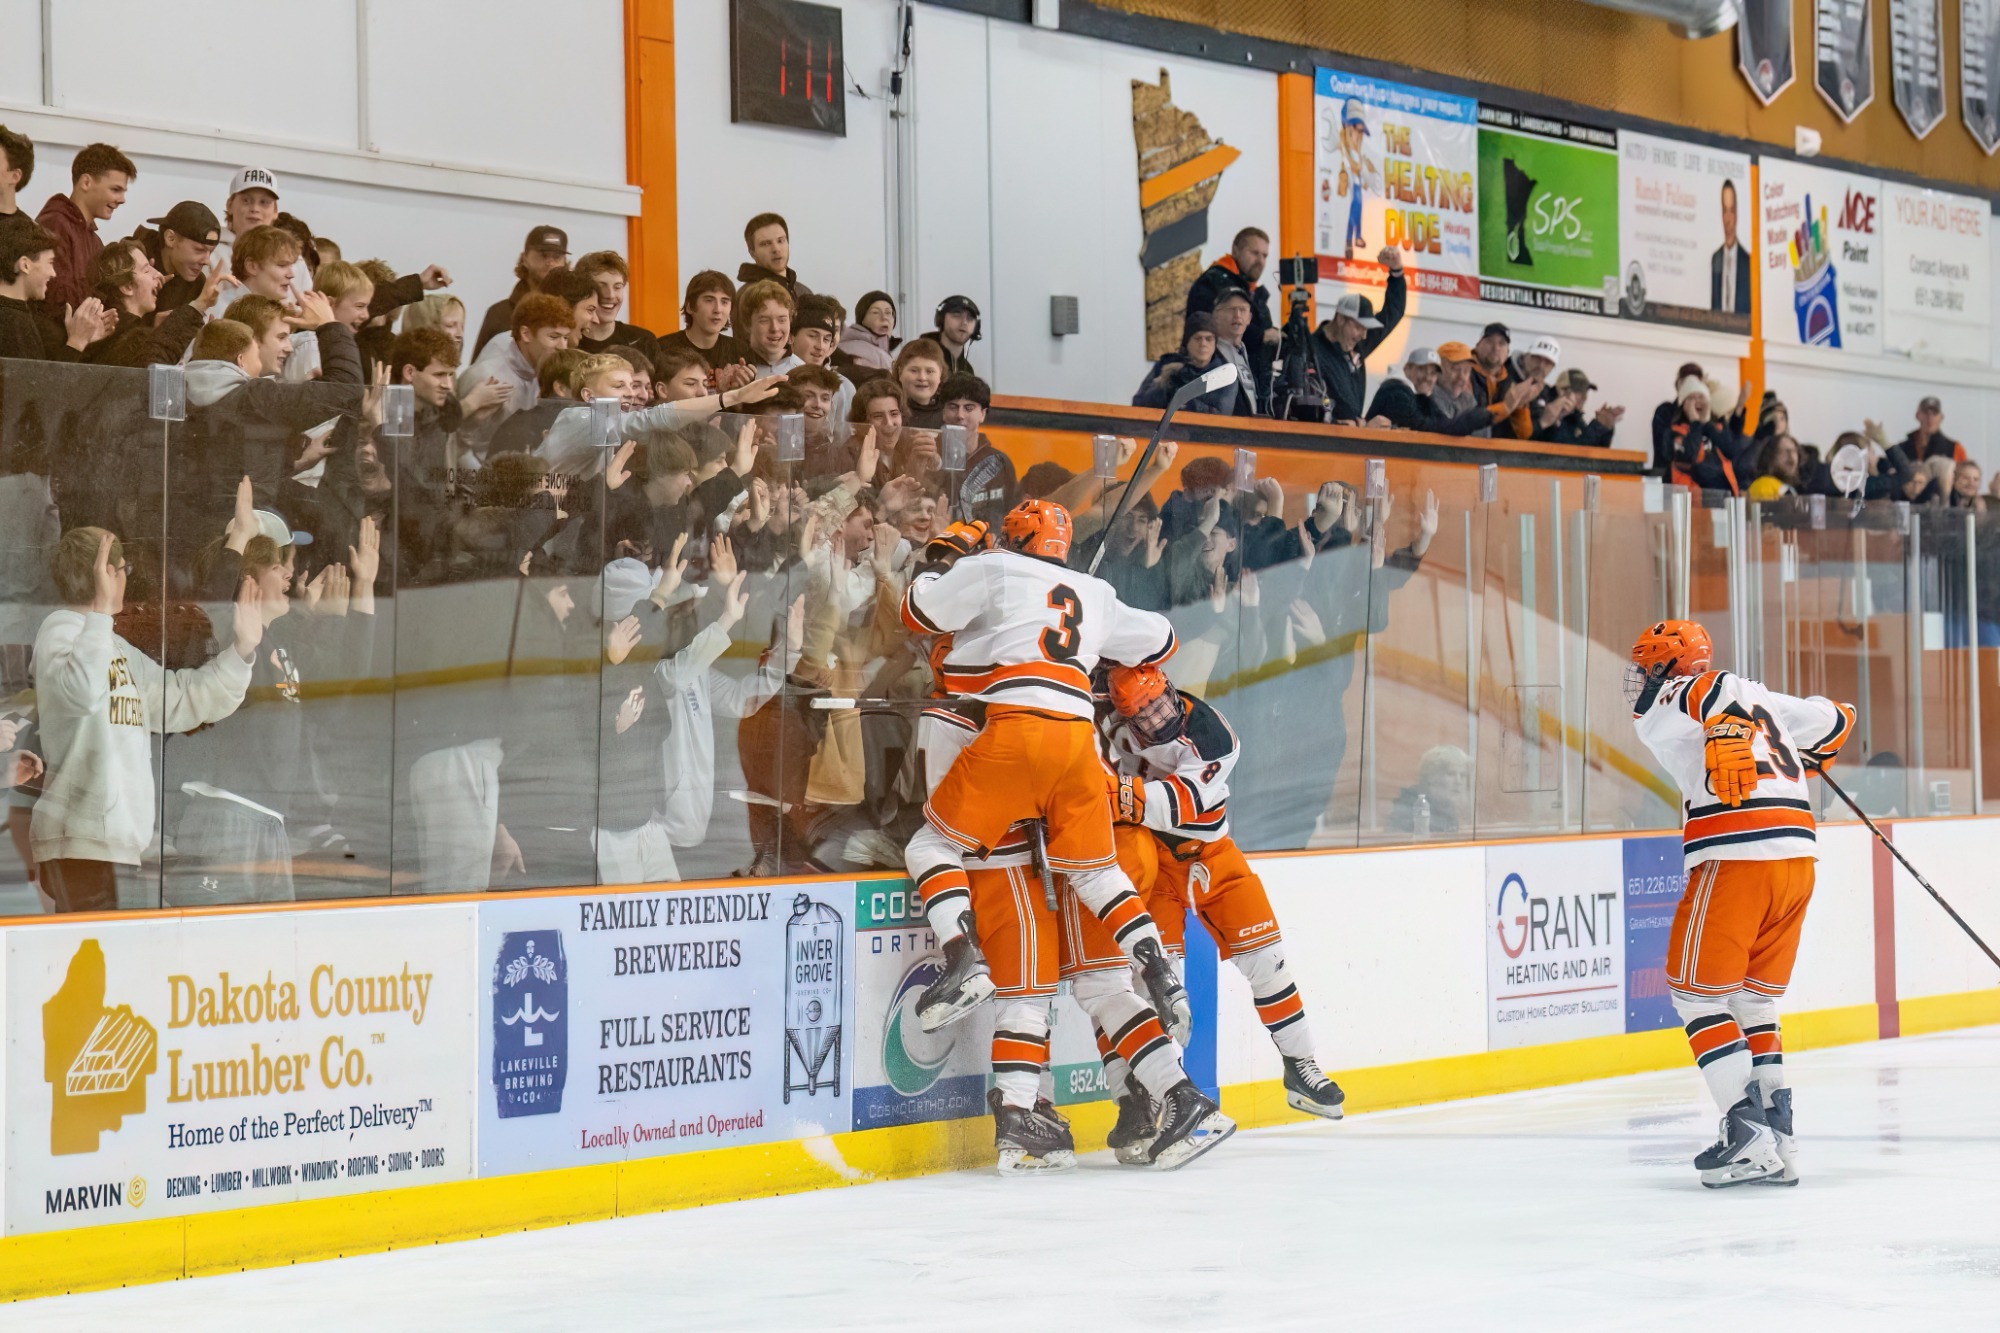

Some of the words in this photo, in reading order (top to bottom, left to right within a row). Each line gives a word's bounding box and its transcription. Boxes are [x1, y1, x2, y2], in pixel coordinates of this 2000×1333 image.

[1383, 122, 1412, 156] THE
[244, 170, 273, 187] FARM
[1384, 157, 1473, 213] HEATING
[1764, 182, 1785, 200] Color
[1532, 191, 1583, 240] SPS
[1765, 202, 1800, 222] Matching
[1838, 184, 1876, 234] ACE
[1895, 193, 1929, 227] YOUR
[1930, 202, 1947, 231] AD
[1948, 205, 1982, 237] HERE
[1385, 208, 1442, 255] DUDE
[1767, 229, 1787, 245] Made
[1768, 251, 1786, 269] Easy
[1843, 240, 1869, 263] Paint
[1480, 283, 1534, 305] RESIDENTIAL
[1544, 292, 1600, 314] COMMERCIAL
[1037, 582, 1084, 661] 3
[1705, 723, 1752, 740] CM
[1200, 760, 1221, 785] 8
[579, 898, 660, 931] FAMILY
[666, 892, 771, 927] FRIENDLY
[872, 891, 924, 920] COS
[1497, 872, 1616, 959] GRANT
[872, 932, 935, 954] ORTH
[1238, 919, 1274, 937] CCM
[613, 939, 741, 976] BREWERIES
[796, 939, 833, 961] INVER
[795, 962, 833, 984] GROVE
[1507, 962, 1559, 985] HEATING
[1562, 959, 1588, 979] AND
[1591, 957, 1611, 976] AIR
[167, 971, 300, 1029] Dakota
[309, 961, 433, 1025] County
[1496, 1007, 1526, 1023] CUSTOM
[1527, 1005, 1547, 1018] HOME
[1548, 1002, 1579, 1016] COMFORT
[1581, 999, 1618, 1013] SOLUTIONS
[600, 1016, 655, 1049] FULL
[661, 1007, 751, 1043] SERVICE
[166, 1043, 311, 1103] Lumber
[500, 1056, 558, 1073] LAKEVILLE
[598, 1050, 752, 1095] RESTAURANTS
[505, 1073, 553, 1090] BREWING
[168, 1122, 224, 1149] Home
[229, 1117, 249, 1142] of
[251, 1114, 279, 1139] the
[283, 1106, 345, 1136] Perfect
[581, 1124, 629, 1149] Locally
[634, 1120, 676, 1142] Owned
[679, 1116, 704, 1136] and
[707, 1109, 764, 1134] Operated
[166, 1175, 201, 1198] DECKING
[211, 1171, 242, 1193] LUMBER
[252, 1164, 292, 1189] MILLWORK
[302, 1159, 338, 1182] WINDOWS
[347, 1154, 378, 1178] ROOFING
[388, 1151, 412, 1173] SIDING
[421, 1148, 445, 1168] DOORS
[45, 1183, 122, 1214] MARVIN
